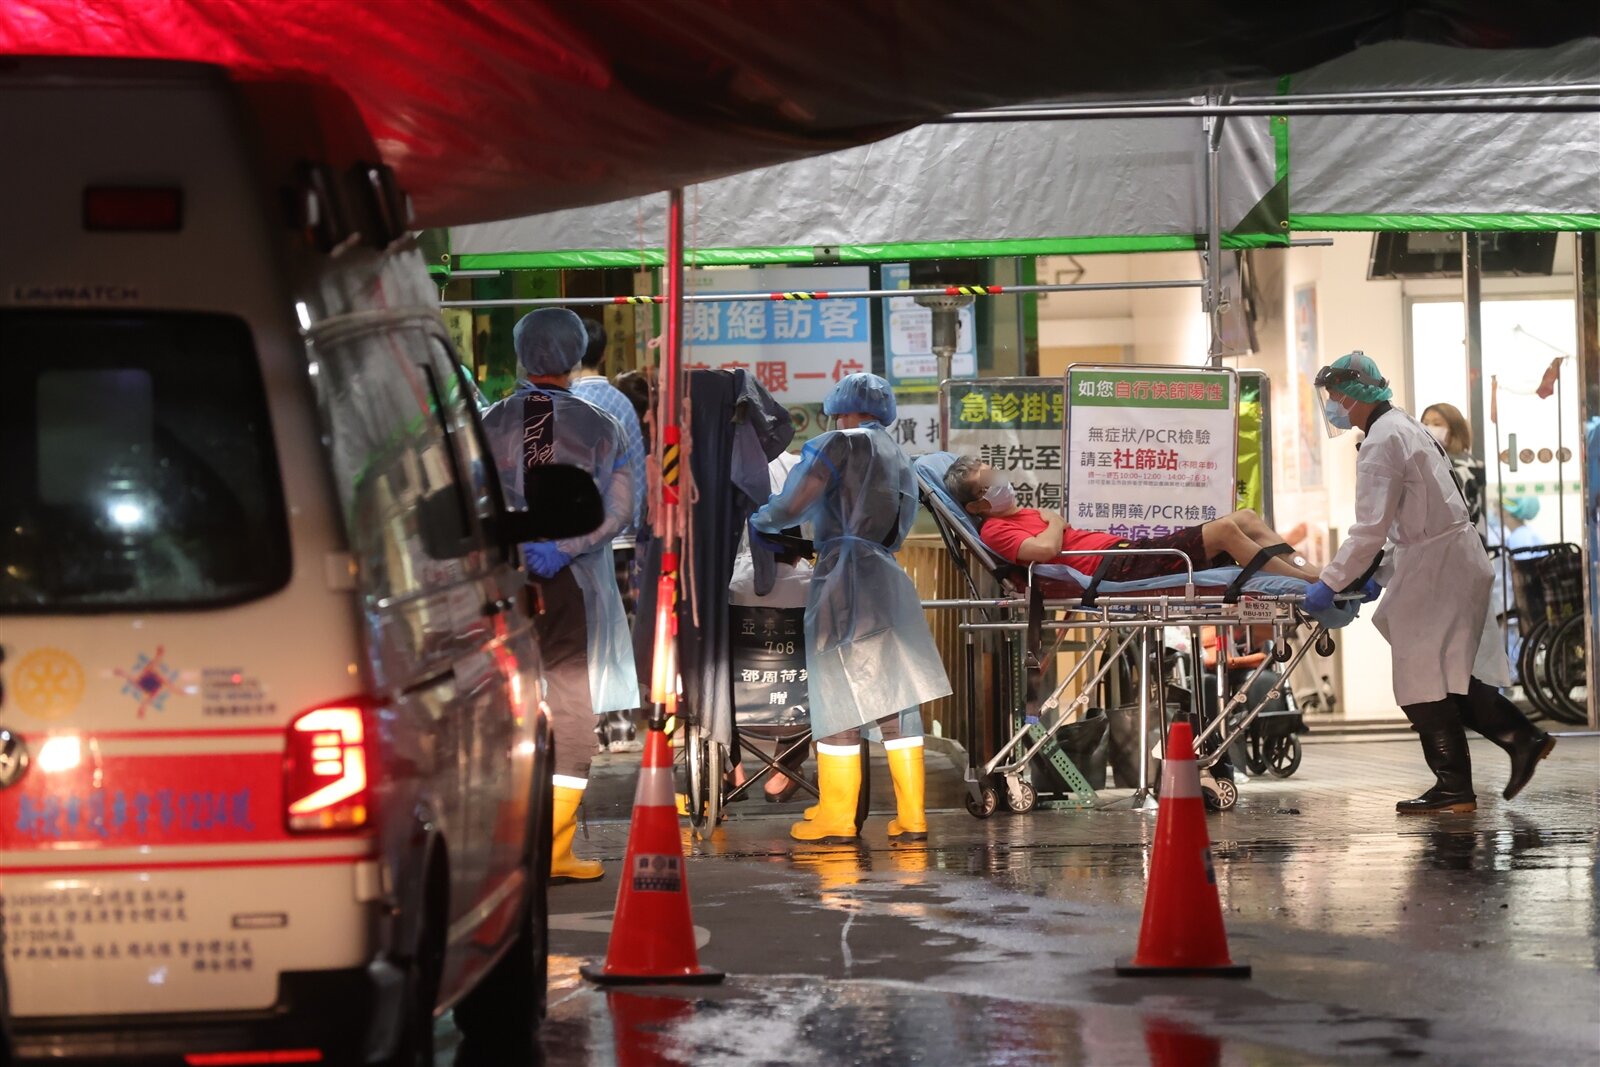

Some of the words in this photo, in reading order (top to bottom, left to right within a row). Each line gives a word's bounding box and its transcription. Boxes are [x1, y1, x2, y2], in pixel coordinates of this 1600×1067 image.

[683, 299, 858, 341] 謝絕訪客
[1078, 380, 1223, 401] 如您自行快篩陽性
[1088, 427, 1211, 445] 無症狀/PCR檢驗
[980, 444, 1061, 472] 請先至
[1078, 502, 1216, 521] 就醫開藥/PCR檢驗
[765, 641, 794, 655] 708
[769, 691, 788, 705] 贈
